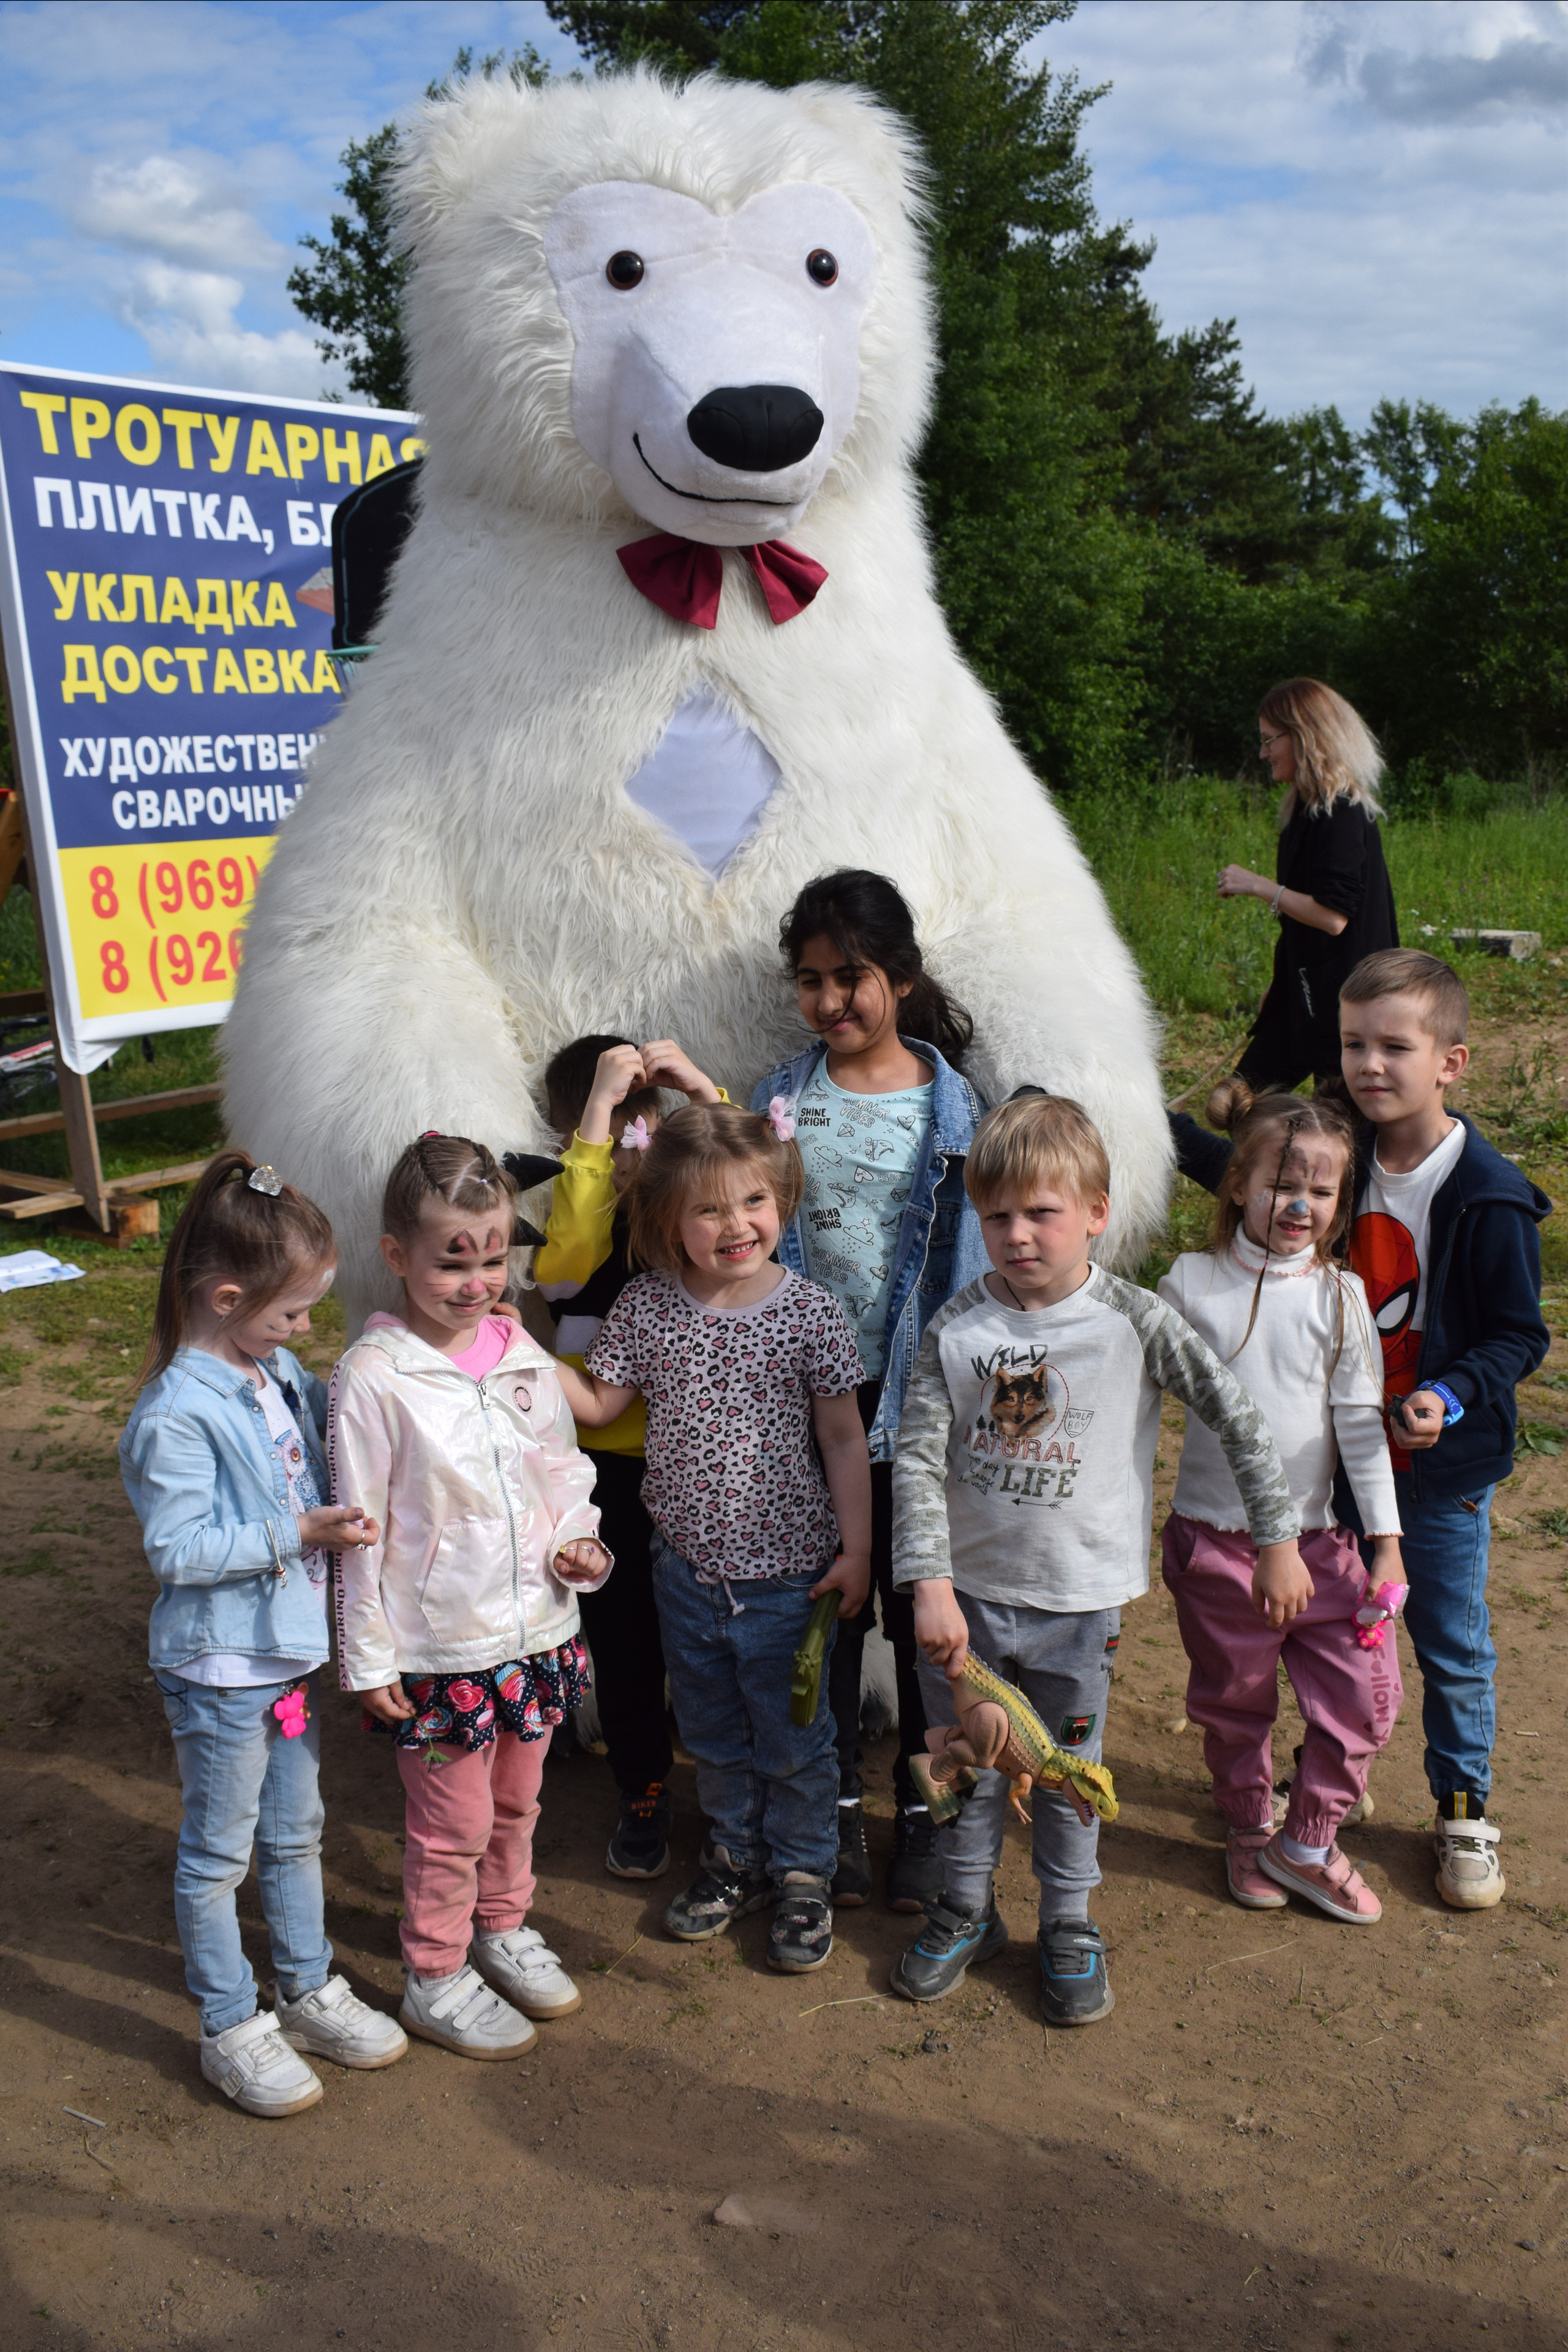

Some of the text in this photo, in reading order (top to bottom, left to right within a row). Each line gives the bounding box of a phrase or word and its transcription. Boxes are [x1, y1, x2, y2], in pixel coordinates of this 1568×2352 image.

[33, 477, 274, 555] ПЛИТКА,
[47, 571, 297, 635] УКЛАДКА
[61, 644, 341, 703] ДОСТАВКА
[59, 734, 326, 783] ХУДОЖЕСТВЕН
[89, 866, 119, 919] 8
[100, 941, 129, 993] 8
[798, 1117, 831, 1127] BRIGHT
[801, 1107, 826, 1117] SHINE
[840, 1104, 875, 1128] VIBES
[808, 1207, 841, 1222] BRIGHT
[814, 1218, 842, 1232] SHINE
[812, 1246, 861, 1276] SUMMER
[813, 1260, 848, 1284] VIBES
[971, 1344, 1048, 1380] WILD
[1068, 1421, 1087, 1430] BOY
[1069, 1411, 1093, 1420] WOLF
[1000, 1464, 1079, 1498] LIFE
